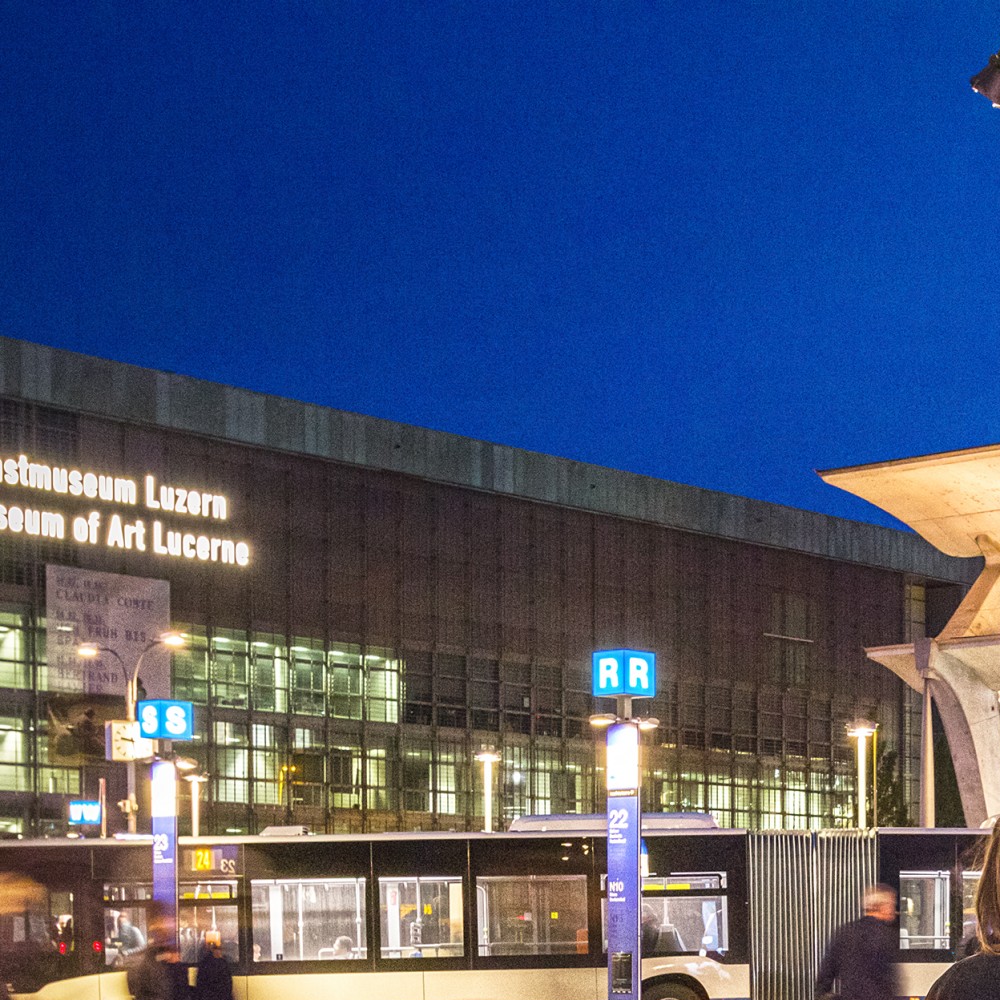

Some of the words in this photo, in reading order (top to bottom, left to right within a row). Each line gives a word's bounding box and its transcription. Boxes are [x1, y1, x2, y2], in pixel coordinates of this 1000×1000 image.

[0, 454, 136, 505] stmuseum
[146, 475, 227, 520] Luzern
[73, 511, 100, 545] of
[107, 514, 145, 552] Art
[153, 521, 249, 566] Lucerne
[599, 657, 619, 689] R
[629, 657, 649, 689] R
[141, 705, 158, 734] S
[165, 705, 187, 735] S
[609, 808, 629, 829] 22
[153, 833, 169, 851] 23
[196, 850, 210, 870] 24
